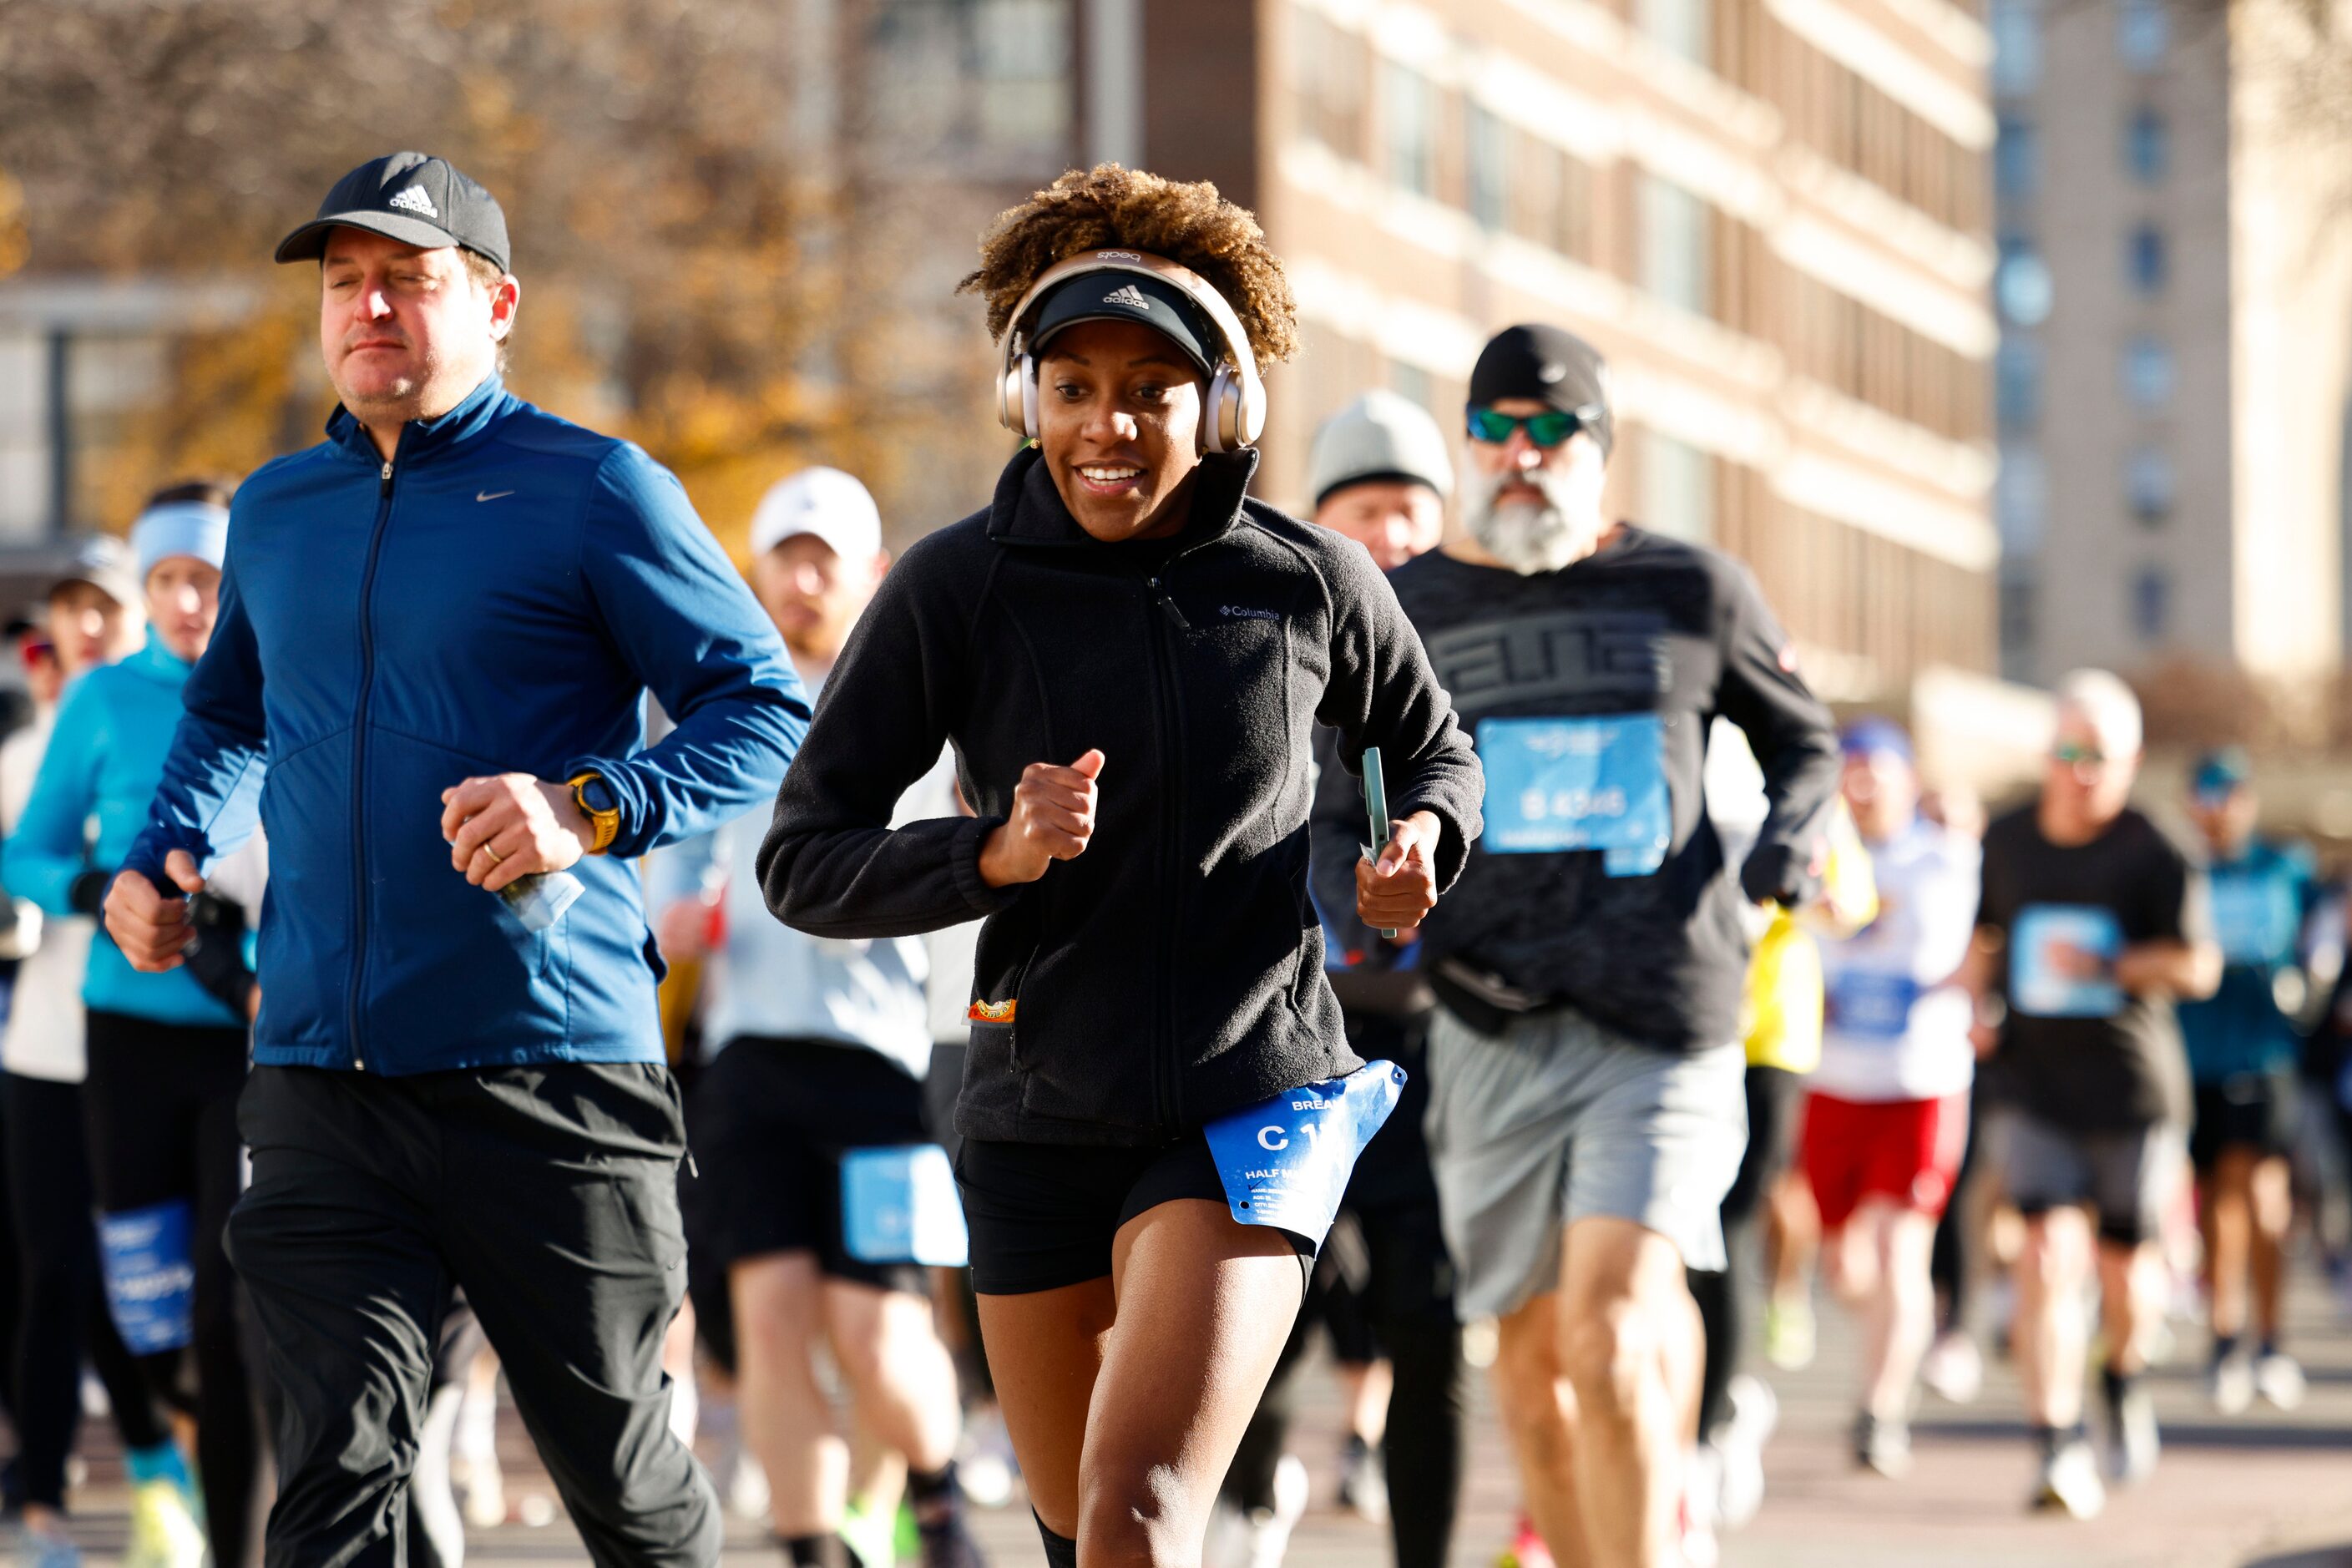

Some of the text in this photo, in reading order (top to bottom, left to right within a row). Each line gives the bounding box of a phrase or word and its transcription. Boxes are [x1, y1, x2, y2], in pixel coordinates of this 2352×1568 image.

[389, 198, 438, 219] adidas
[1097, 251, 1141, 262] beats
[1103, 296, 1149, 310] adidas
[1232, 605, 1280, 620] Columbia
[1257, 1125, 1289, 1151] C
[1245, 1169, 1279, 1180] HALF
